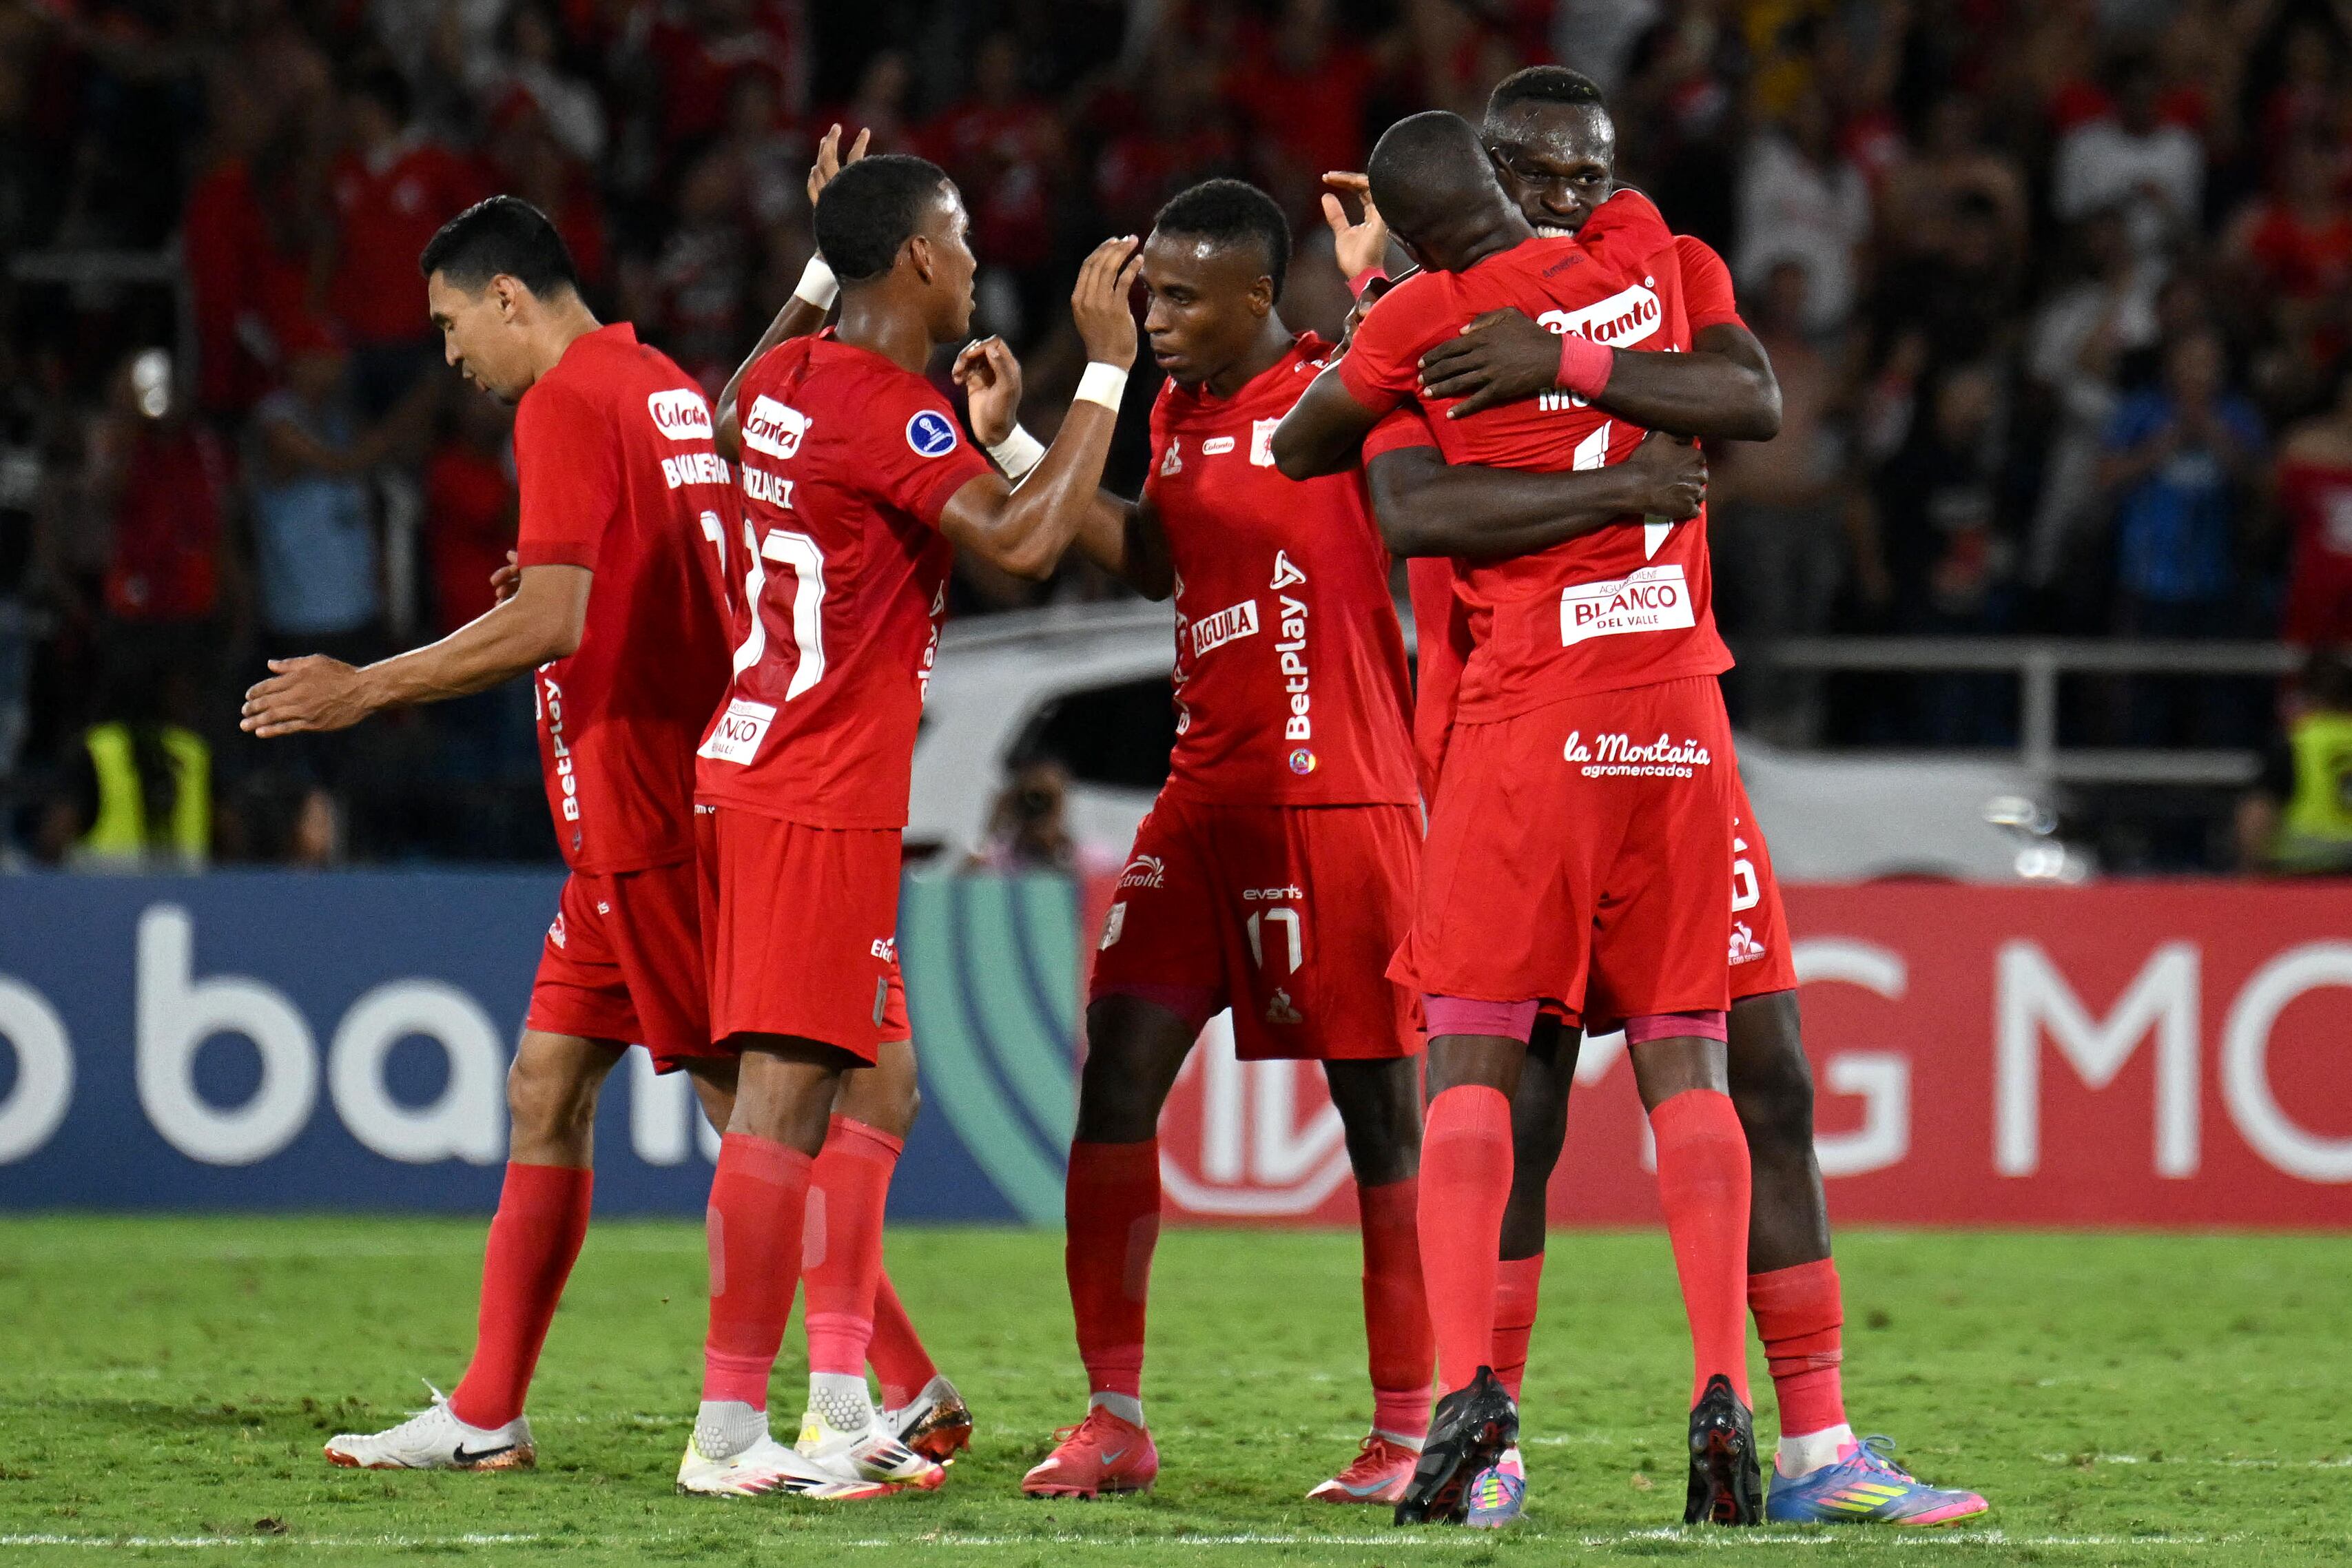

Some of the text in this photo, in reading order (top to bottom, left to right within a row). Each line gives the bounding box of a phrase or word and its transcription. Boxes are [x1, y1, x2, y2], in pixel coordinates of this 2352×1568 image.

[1575, 586, 1677, 626] BLANCO
[1597, 615, 1659, 629] DEL VALLE
[1196, 606, 1252, 654] AGUILA
[1274, 594, 1311, 741] BetPlay
[544, 677, 580, 822] BetPlay
[1563, 730, 1711, 766] la Montaña
[1580, 763, 1693, 779] agromercados
[1247, 907, 1303, 976] 17
